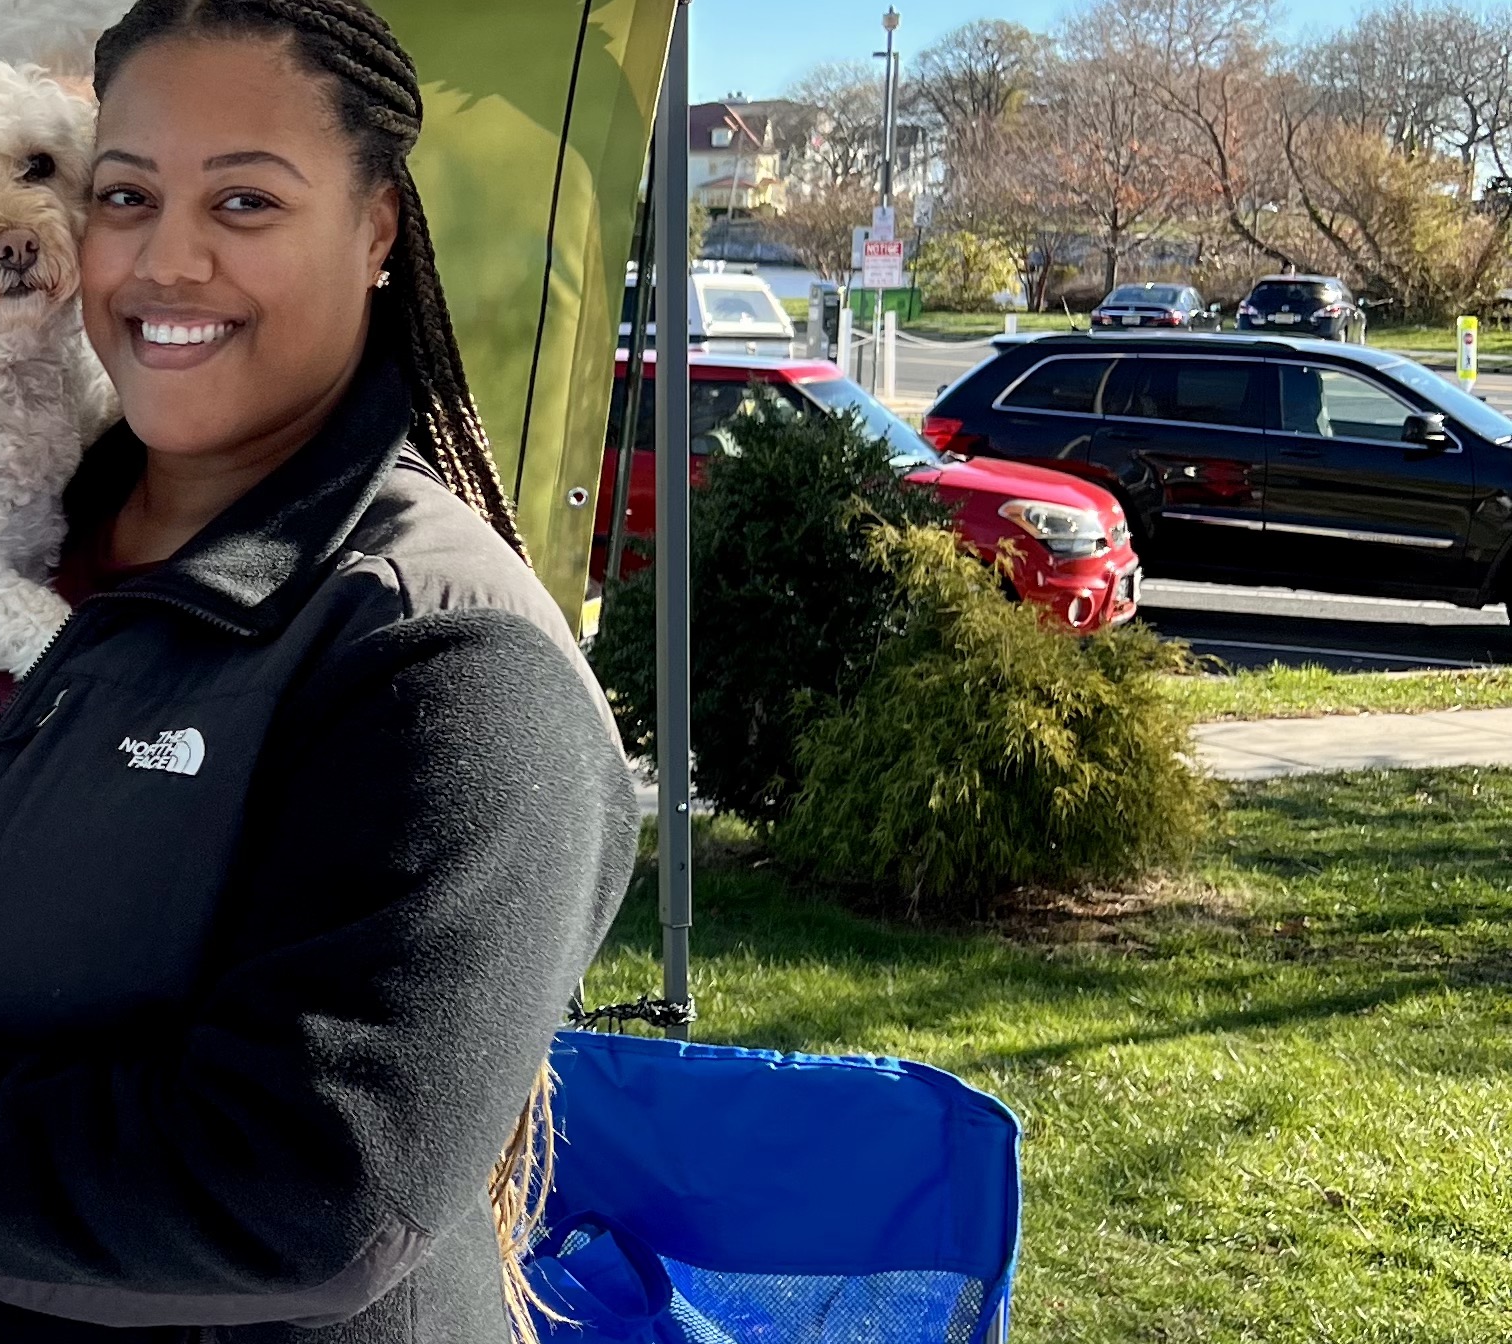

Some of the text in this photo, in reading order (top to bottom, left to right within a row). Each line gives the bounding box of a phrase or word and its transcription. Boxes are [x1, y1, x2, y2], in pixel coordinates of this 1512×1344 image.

[867, 243, 899, 255] NOTICE
[155, 730, 187, 744] THE
[117, 736, 178, 757] NORTH
[127, 755, 172, 770] FACE
